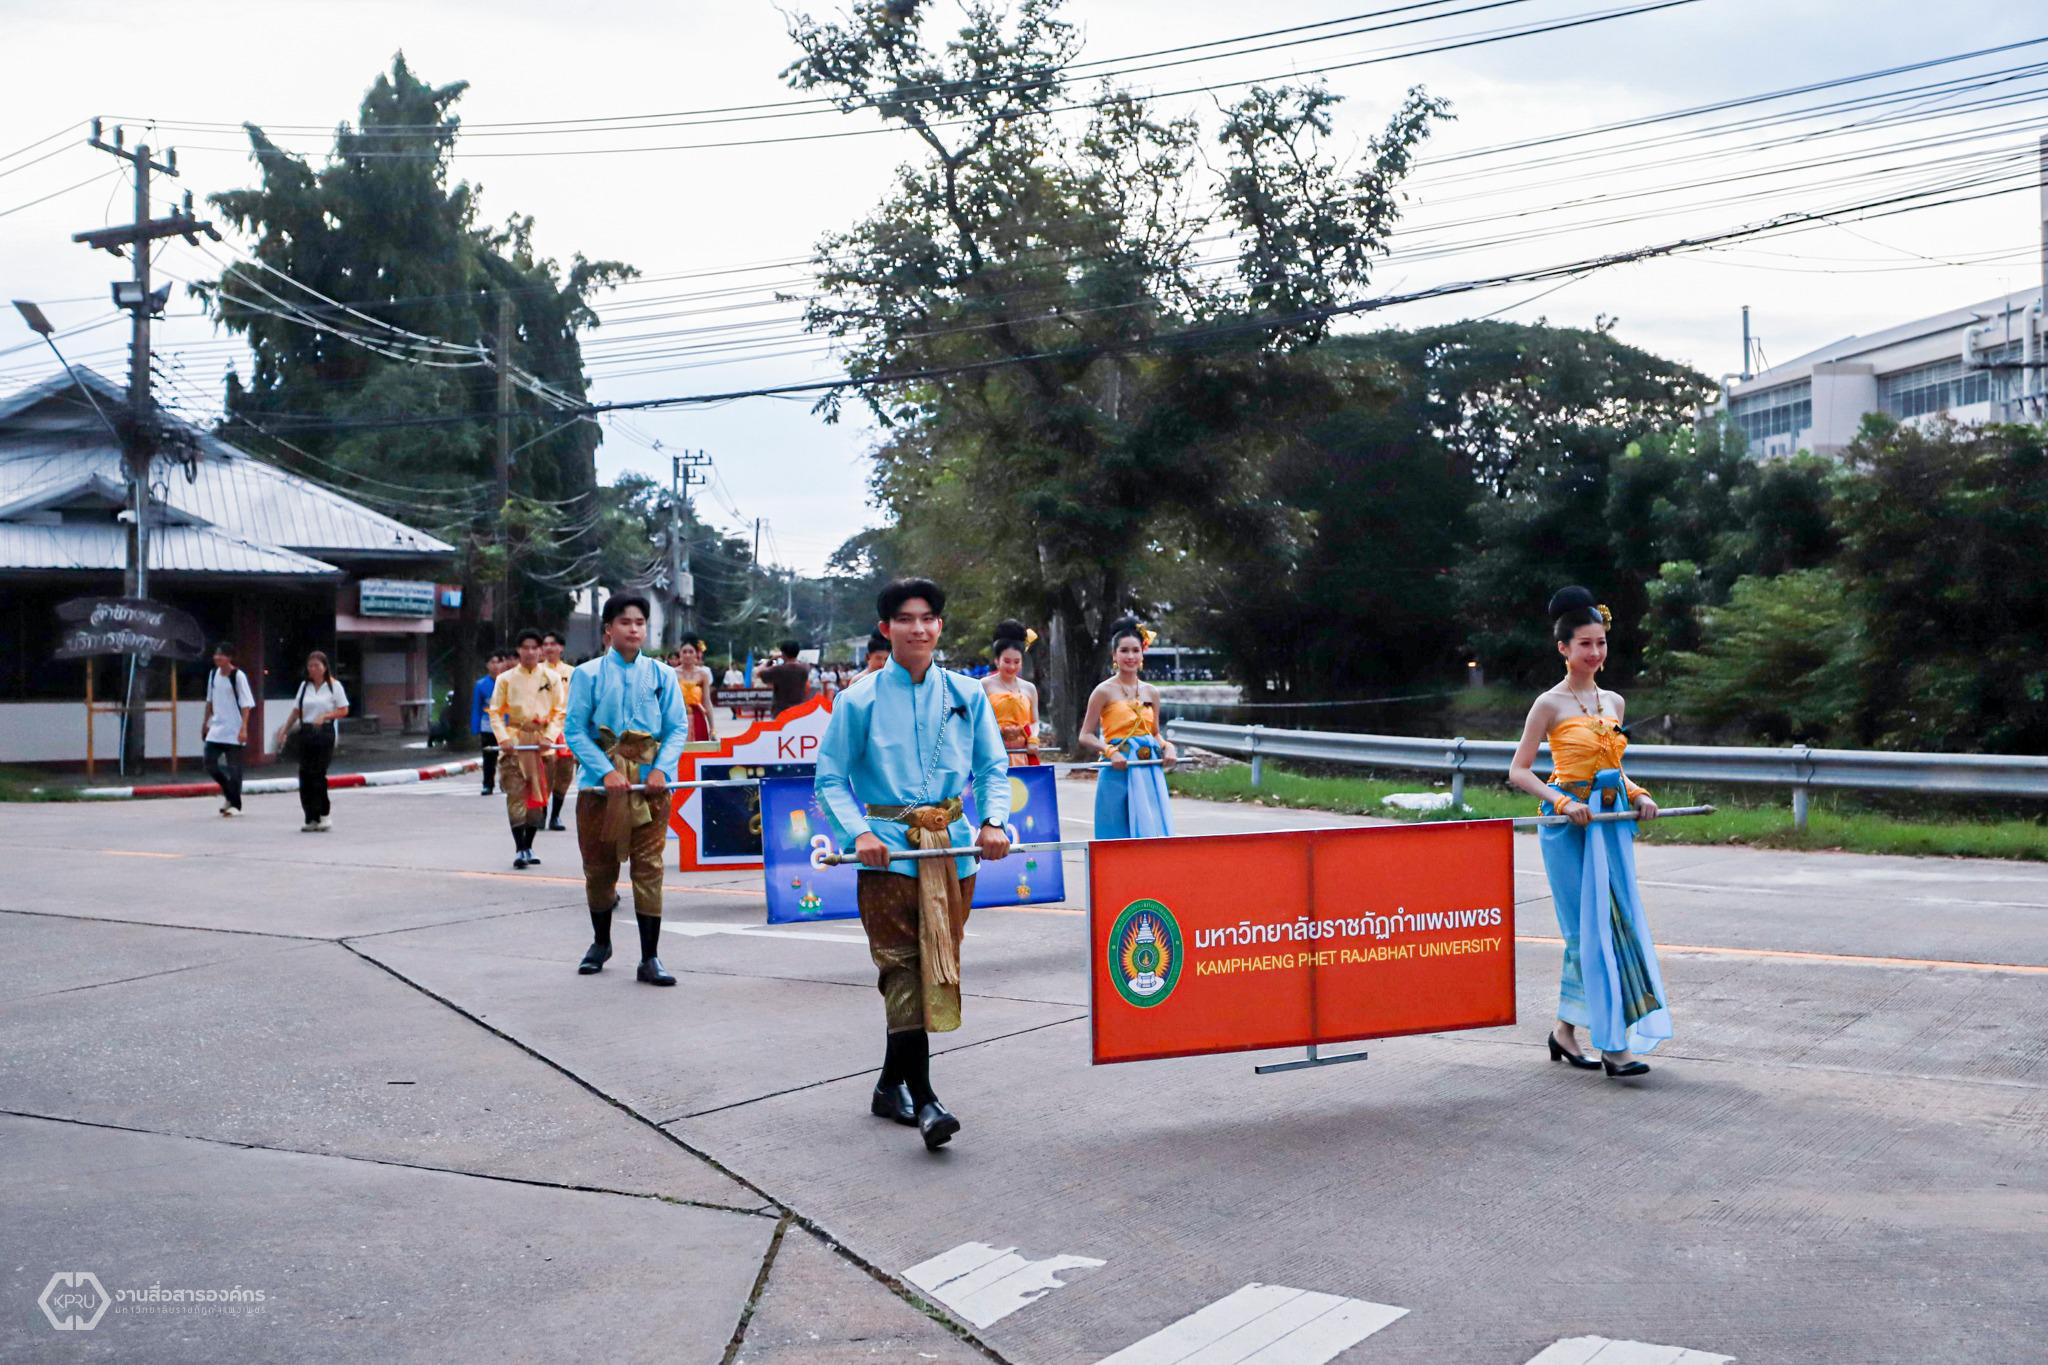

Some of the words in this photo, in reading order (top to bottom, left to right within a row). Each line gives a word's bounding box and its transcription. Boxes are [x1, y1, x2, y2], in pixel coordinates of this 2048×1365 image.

[1195, 907, 1502, 948] มหาวิทยาลัยราชภัฏกำแพงเพชร
[1196, 953, 1294, 976] KAMPHAENG
[1298, 950, 1337, 968] PHET
[1341, 944, 1415, 964] RAJABHAT
[1419, 937, 1502, 958] UNIVERSITY
